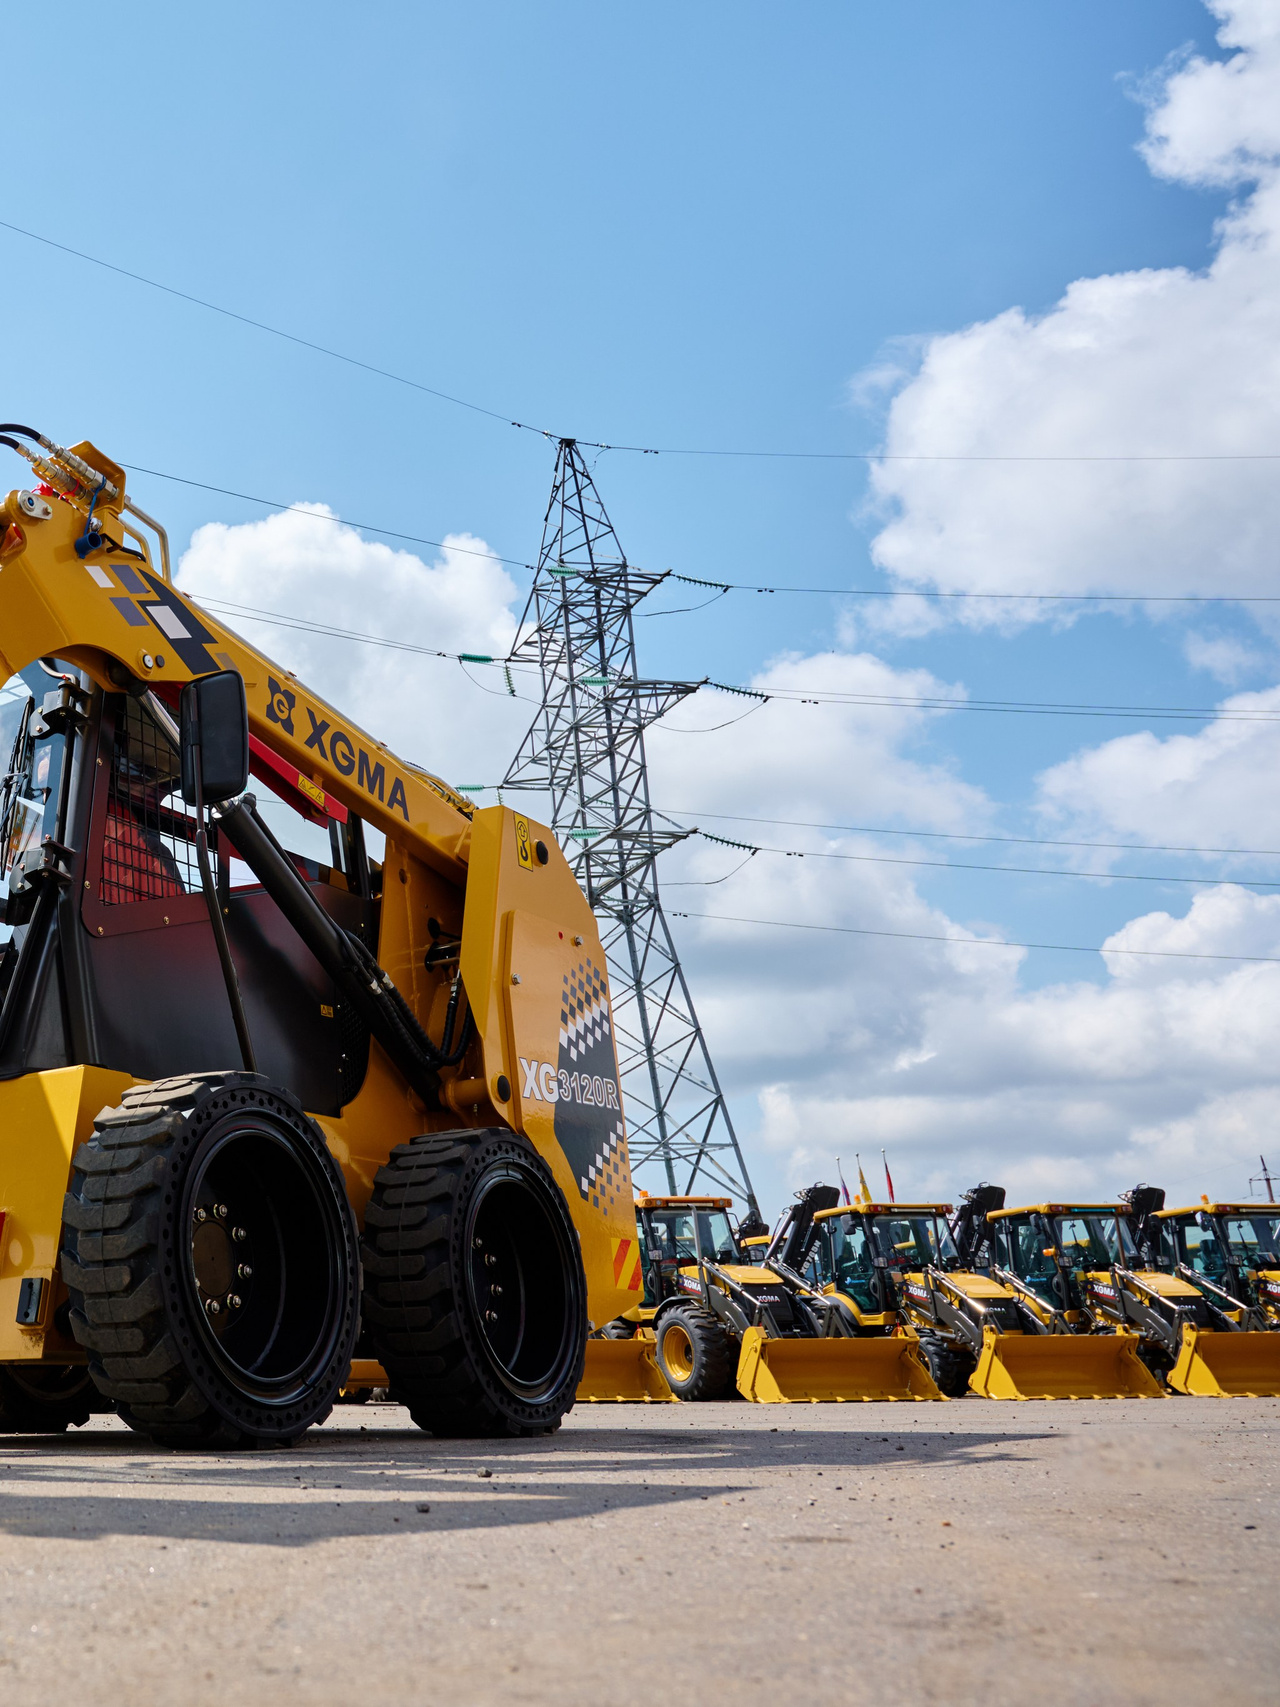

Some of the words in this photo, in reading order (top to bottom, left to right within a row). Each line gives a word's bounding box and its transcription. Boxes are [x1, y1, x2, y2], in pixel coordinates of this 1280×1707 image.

[304, 706, 410, 822] XGMA
[519, 1057, 620, 1110] XG3120R
[683, 1278, 701, 1291] XGMA
